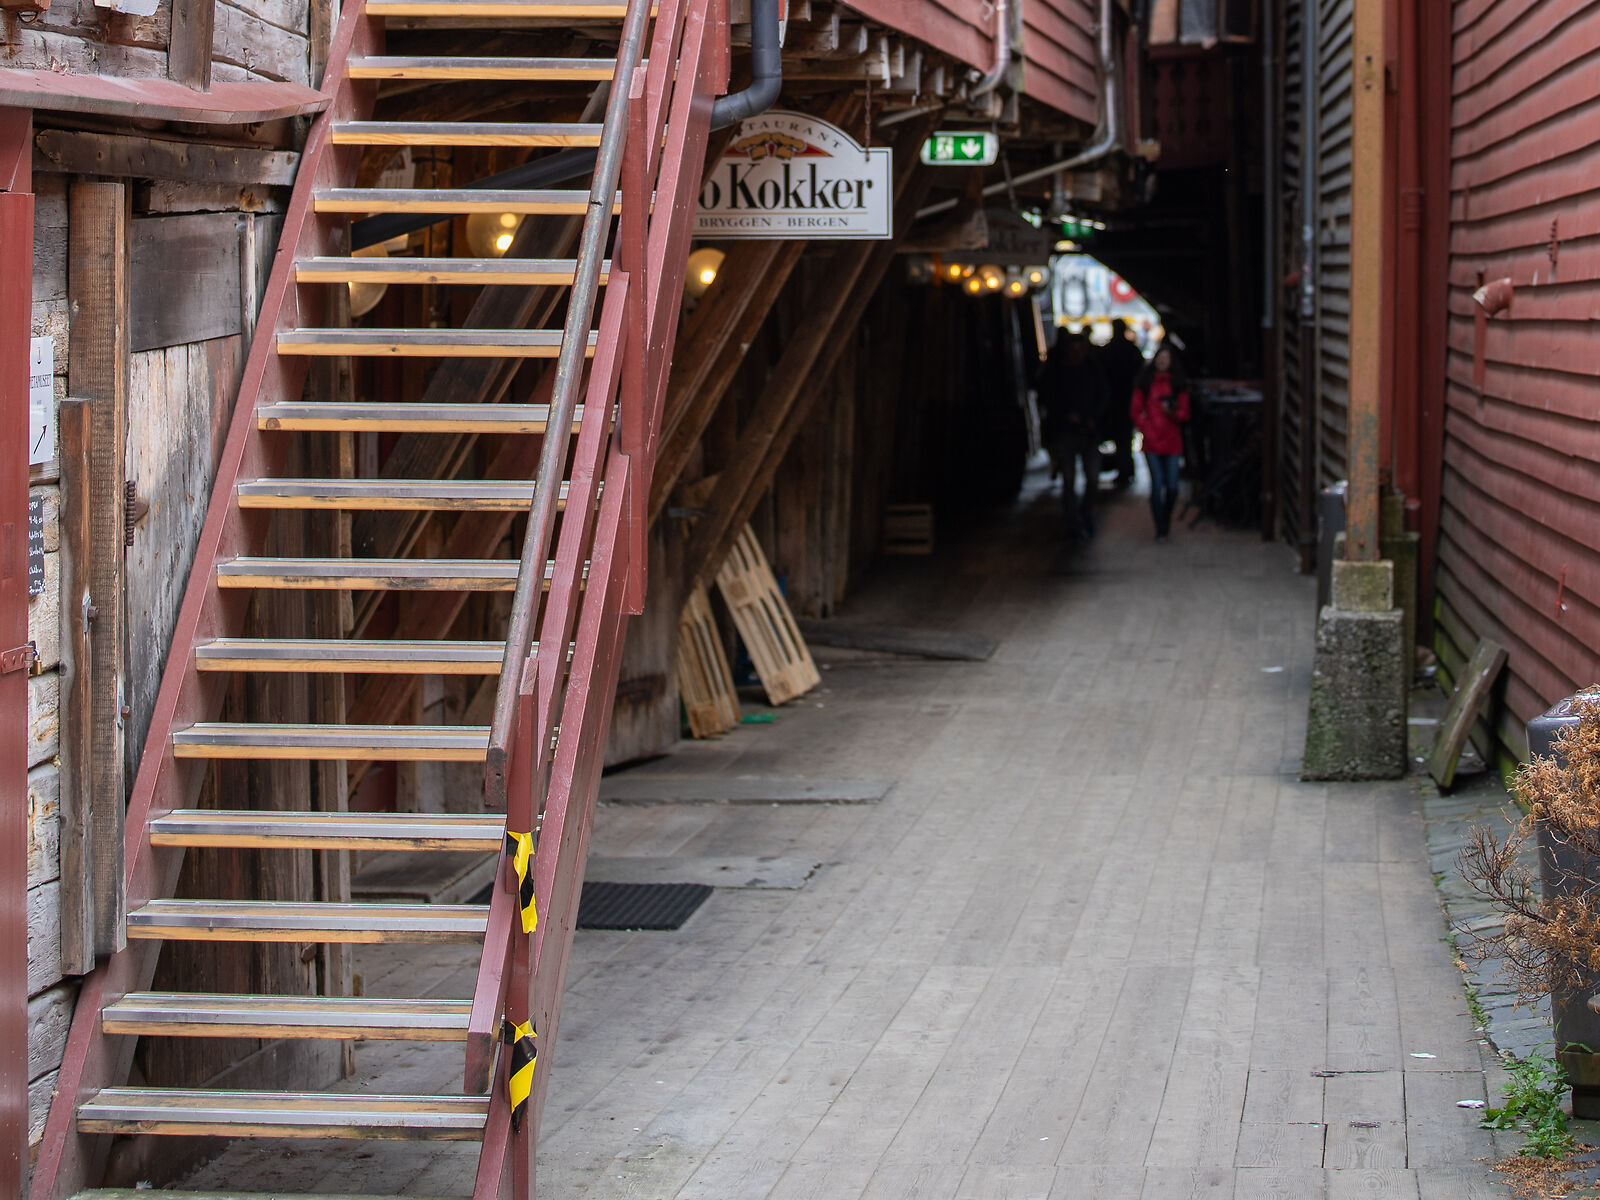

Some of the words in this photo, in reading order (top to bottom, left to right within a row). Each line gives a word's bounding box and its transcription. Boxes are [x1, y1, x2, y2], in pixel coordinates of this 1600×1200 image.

[746, 119, 843, 149] TAURANT
[698, 179, 721, 210] o
[727, 162, 873, 210] Kokker
[699, 217, 772, 228] BRYGGEN
[787, 217, 849, 228] BERGEN
[30, 374, 52, 389] ETAMUSEET
